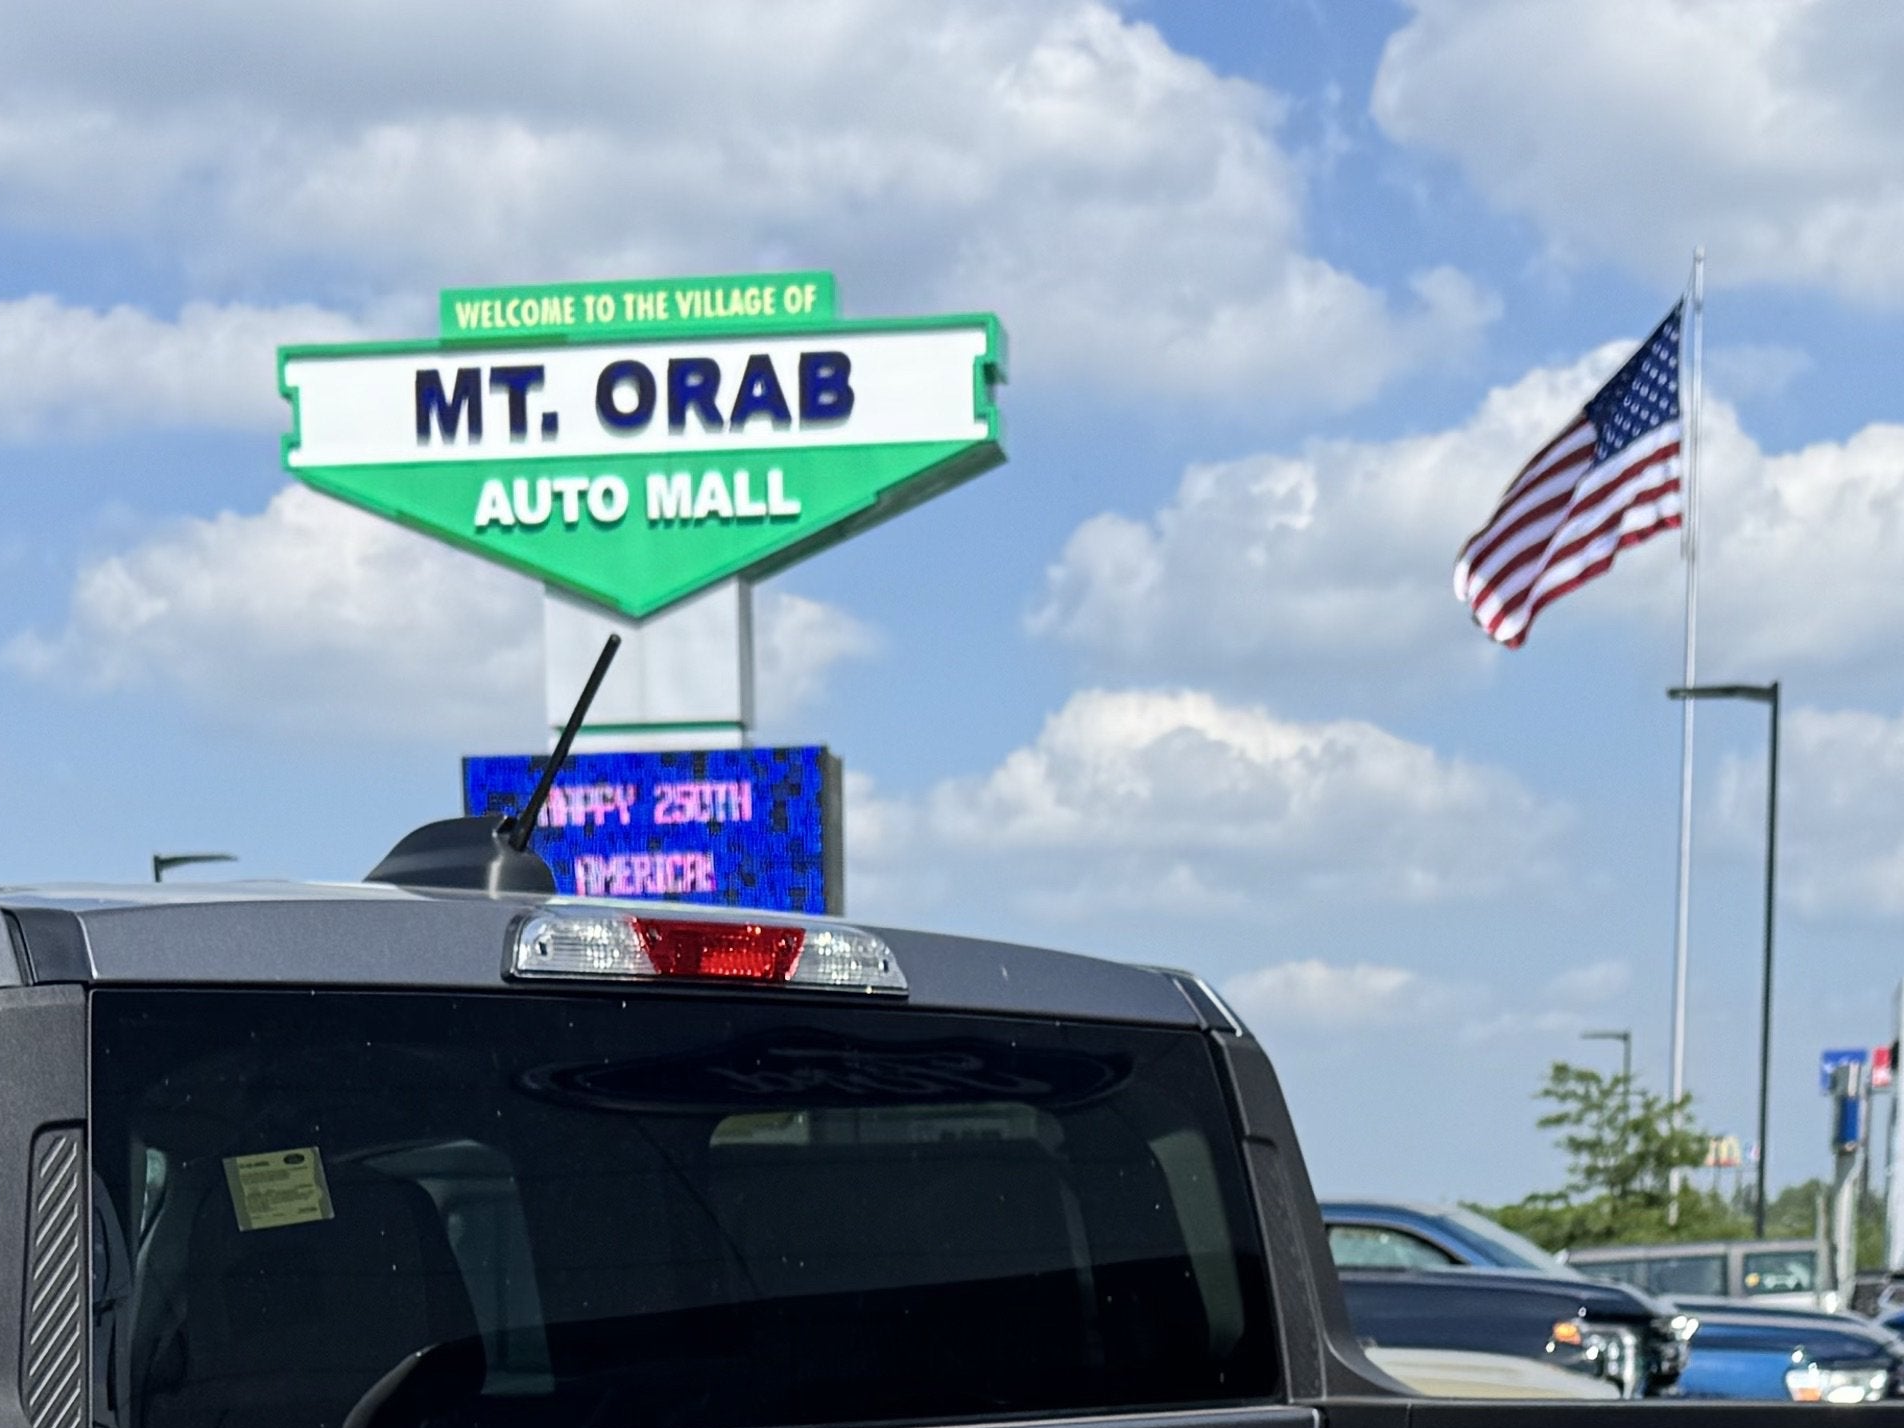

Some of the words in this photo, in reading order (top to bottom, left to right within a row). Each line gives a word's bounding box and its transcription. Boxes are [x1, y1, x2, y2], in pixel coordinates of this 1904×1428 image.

[455, 296, 575, 330] WELCOME
[583, 294, 615, 323] TO
[623, 291, 669, 322] THE
[675, 285, 776, 319] VILLAGE
[784, 284, 817, 314] OF
[415, 364, 559, 443] MT.
[596, 351, 855, 437] ORAB
[474, 474, 630, 528] AUTO
[646, 468, 802, 521] MALL
[539, 783, 637, 828] APPY
